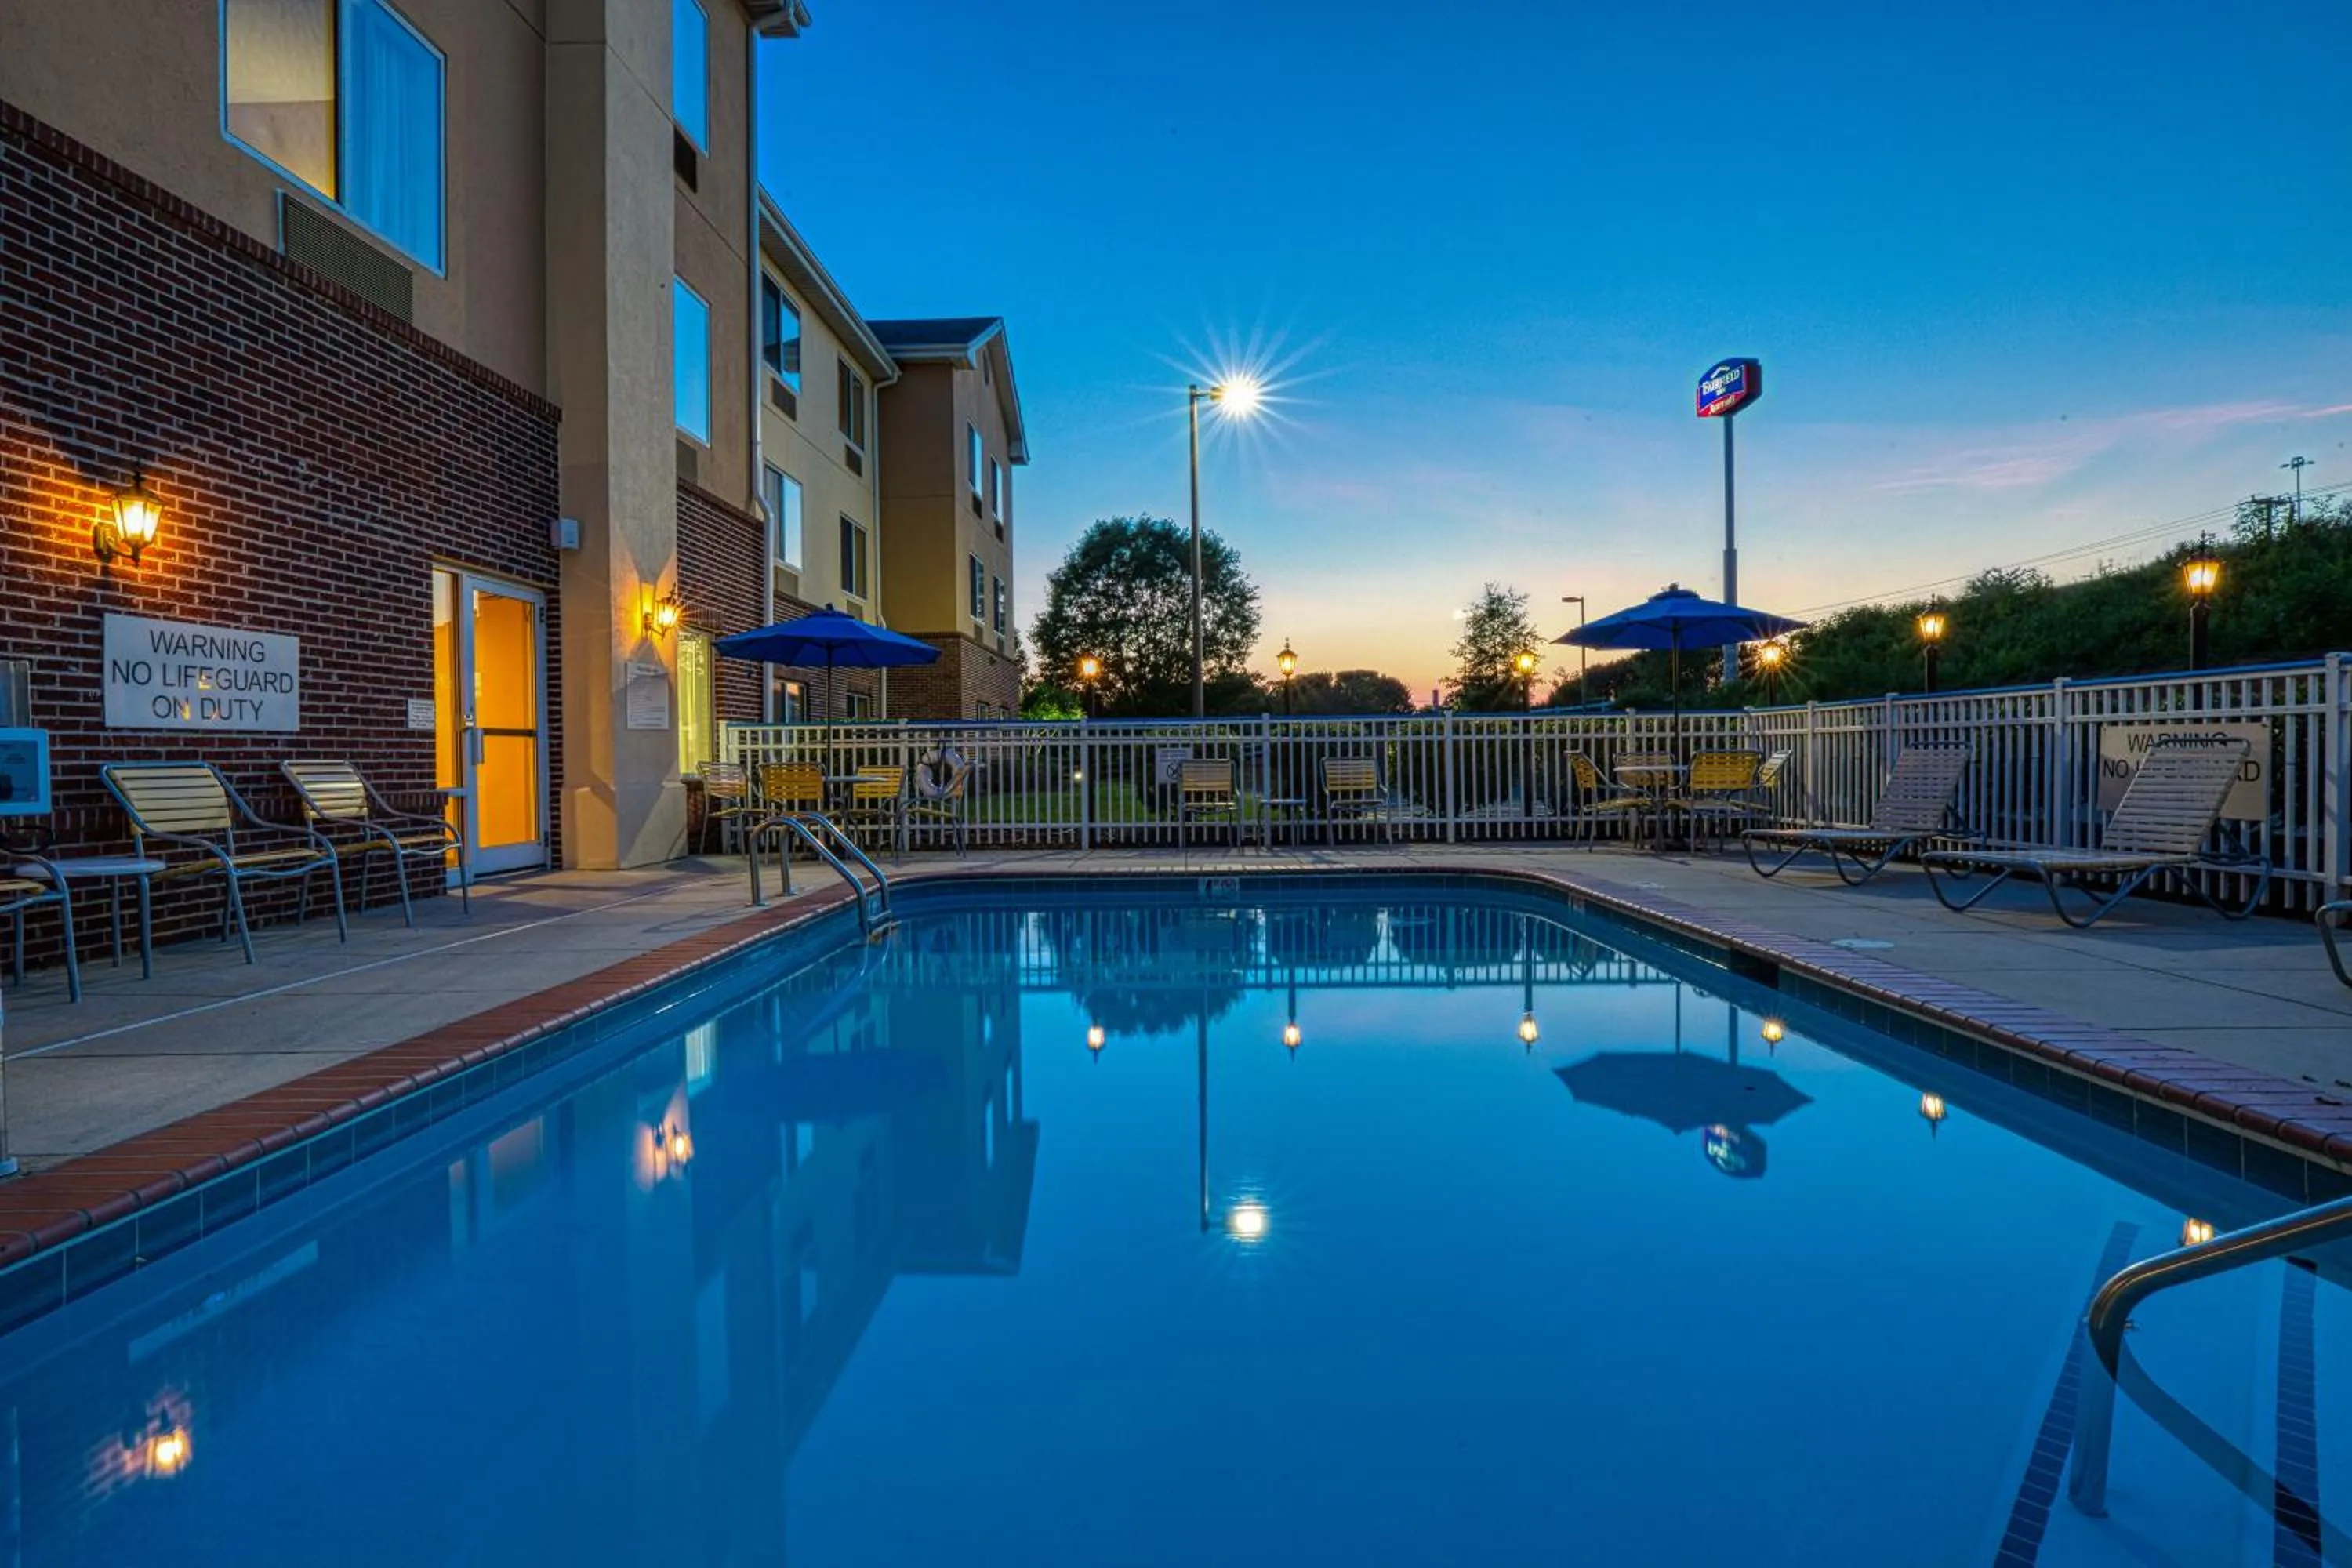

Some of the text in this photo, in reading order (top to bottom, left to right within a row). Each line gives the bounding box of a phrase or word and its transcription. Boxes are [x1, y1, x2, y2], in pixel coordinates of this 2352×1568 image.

[150, 630, 266, 663] WARNING
[111, 659, 294, 694] NO LIFEGUARD
[151, 695, 264, 722] ON DUTY
[2103, 759, 2129, 779] NO
